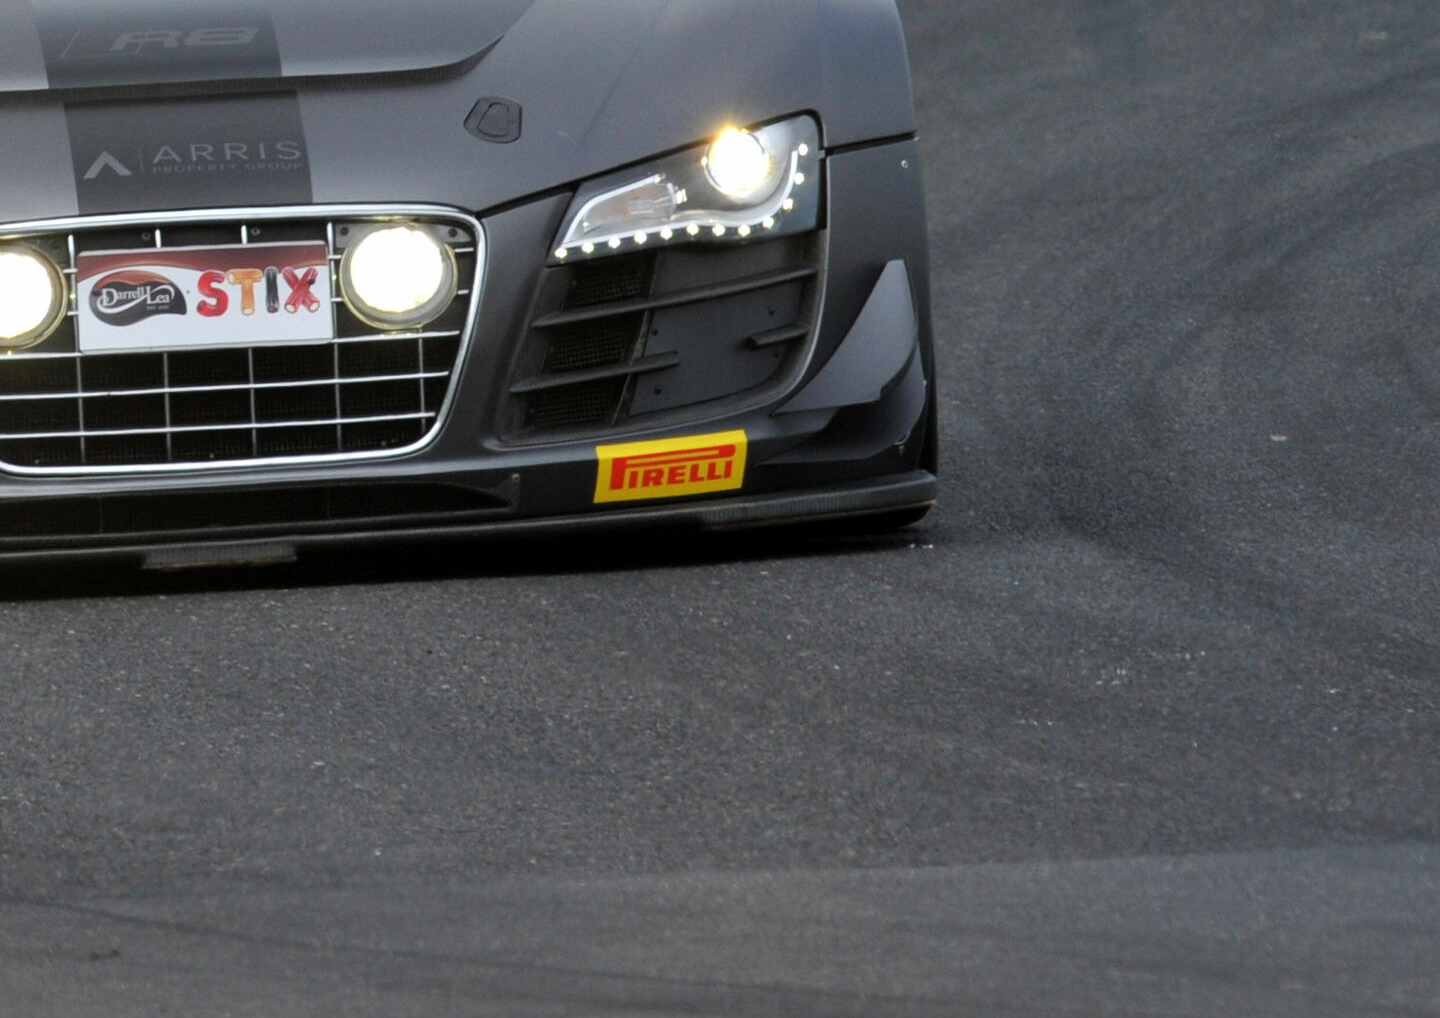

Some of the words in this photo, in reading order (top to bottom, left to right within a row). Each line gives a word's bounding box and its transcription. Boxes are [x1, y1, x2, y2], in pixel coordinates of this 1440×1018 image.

[152, 140, 303, 164] ARRIS
[245, 160, 304, 172] GROUP
[100, 285, 145, 307] Darrell
[145, 285, 171, 305] Lea
[195, 265, 321, 318] STIX
[609, 443, 737, 491] PIRELLI
